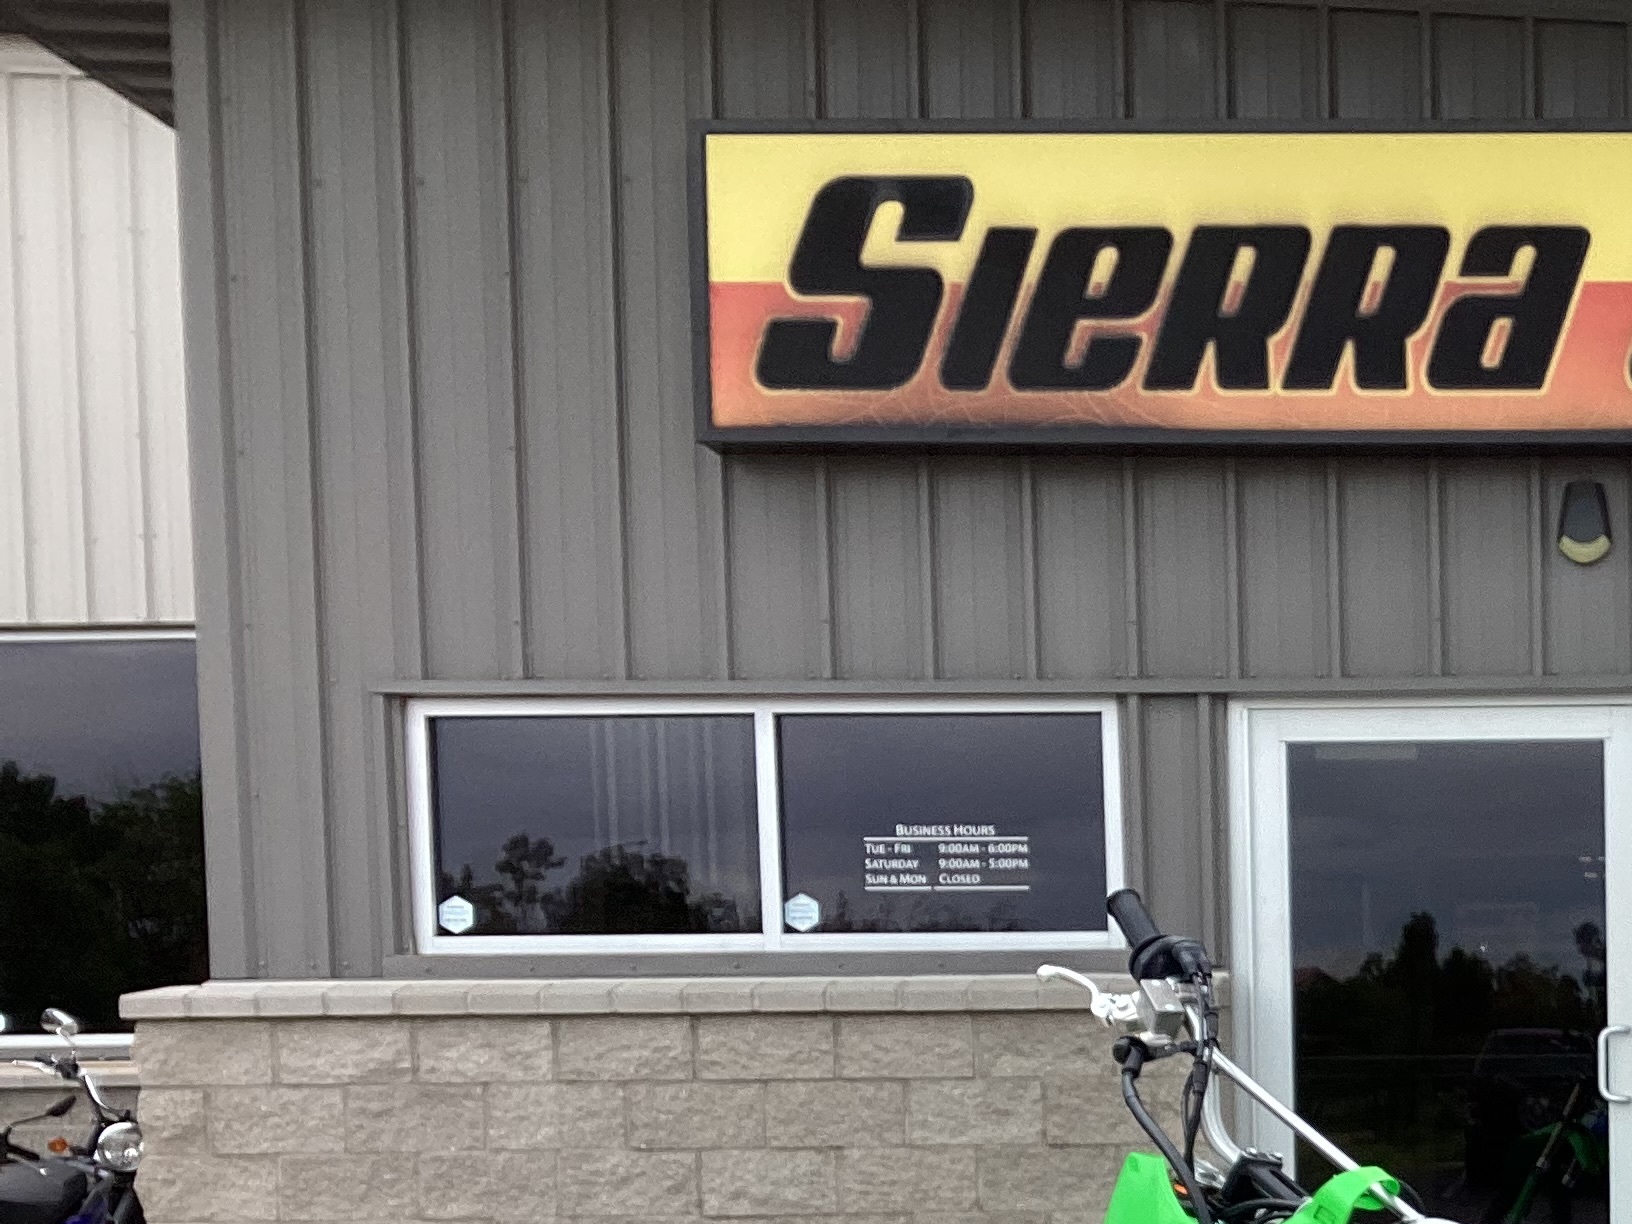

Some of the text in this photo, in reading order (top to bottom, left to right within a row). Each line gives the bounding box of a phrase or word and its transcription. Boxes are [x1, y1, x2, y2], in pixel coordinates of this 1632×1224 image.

[938, 843, 980, 854] 9:00AM
[988, 843, 1028, 854] 6:00PM
[938, 858, 980, 869] 9:00AM
[988, 858, 1028, 869] 5:00PM
